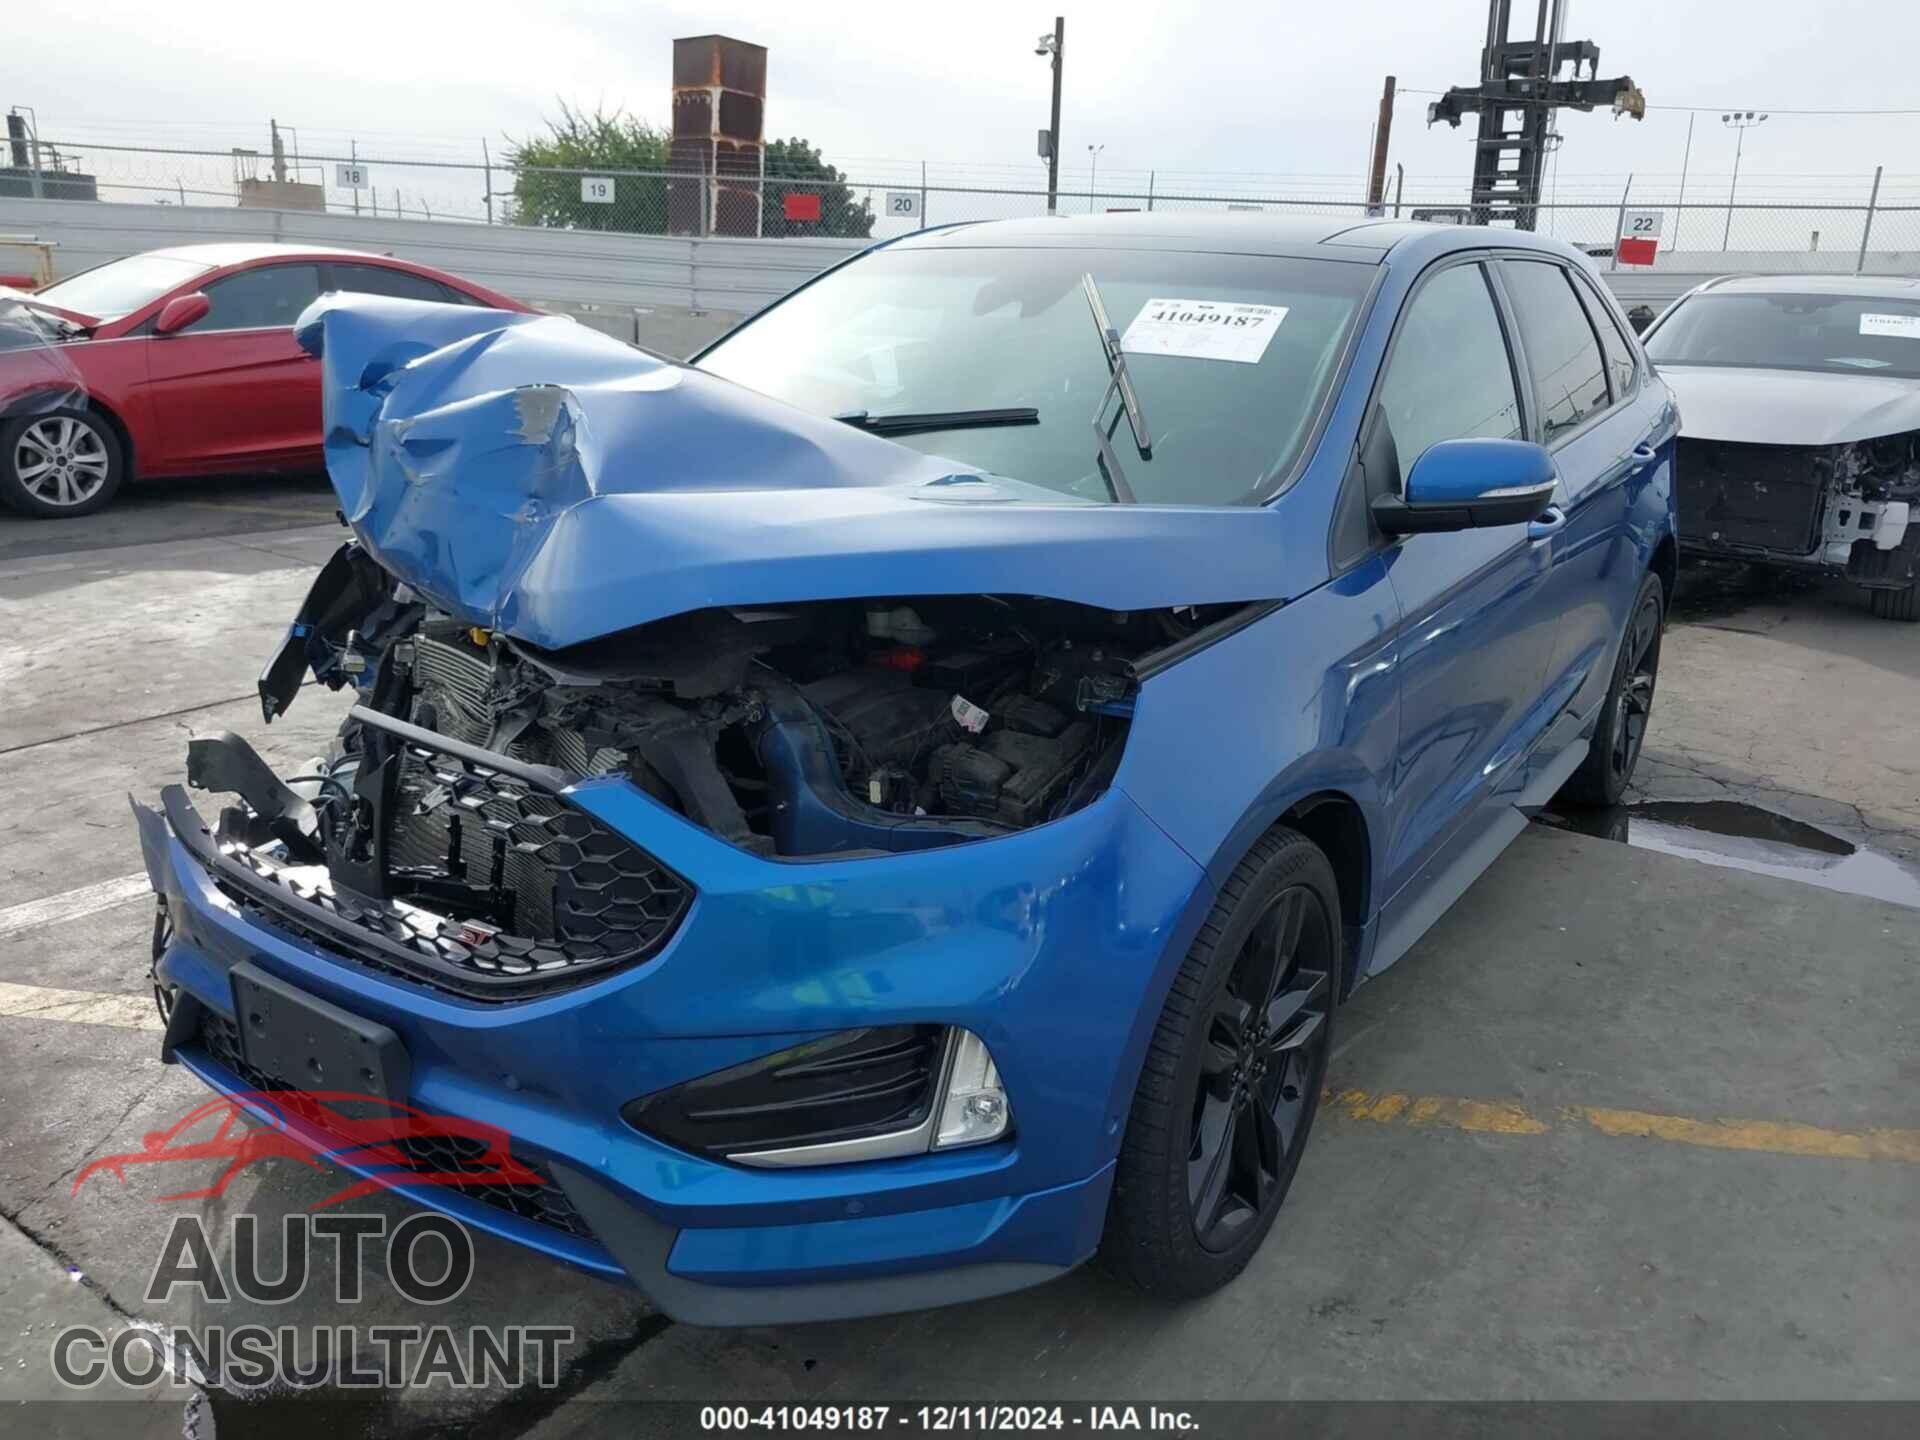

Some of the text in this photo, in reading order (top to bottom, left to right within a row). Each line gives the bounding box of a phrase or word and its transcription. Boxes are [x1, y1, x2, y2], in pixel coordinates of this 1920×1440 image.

[345, 171, 360, 183] 18
[590, 184, 607, 197] 19
[894, 198, 912, 212] 20
[1633, 218, 1653, 231] 22
[1152, 310, 1265, 328] 41049187
